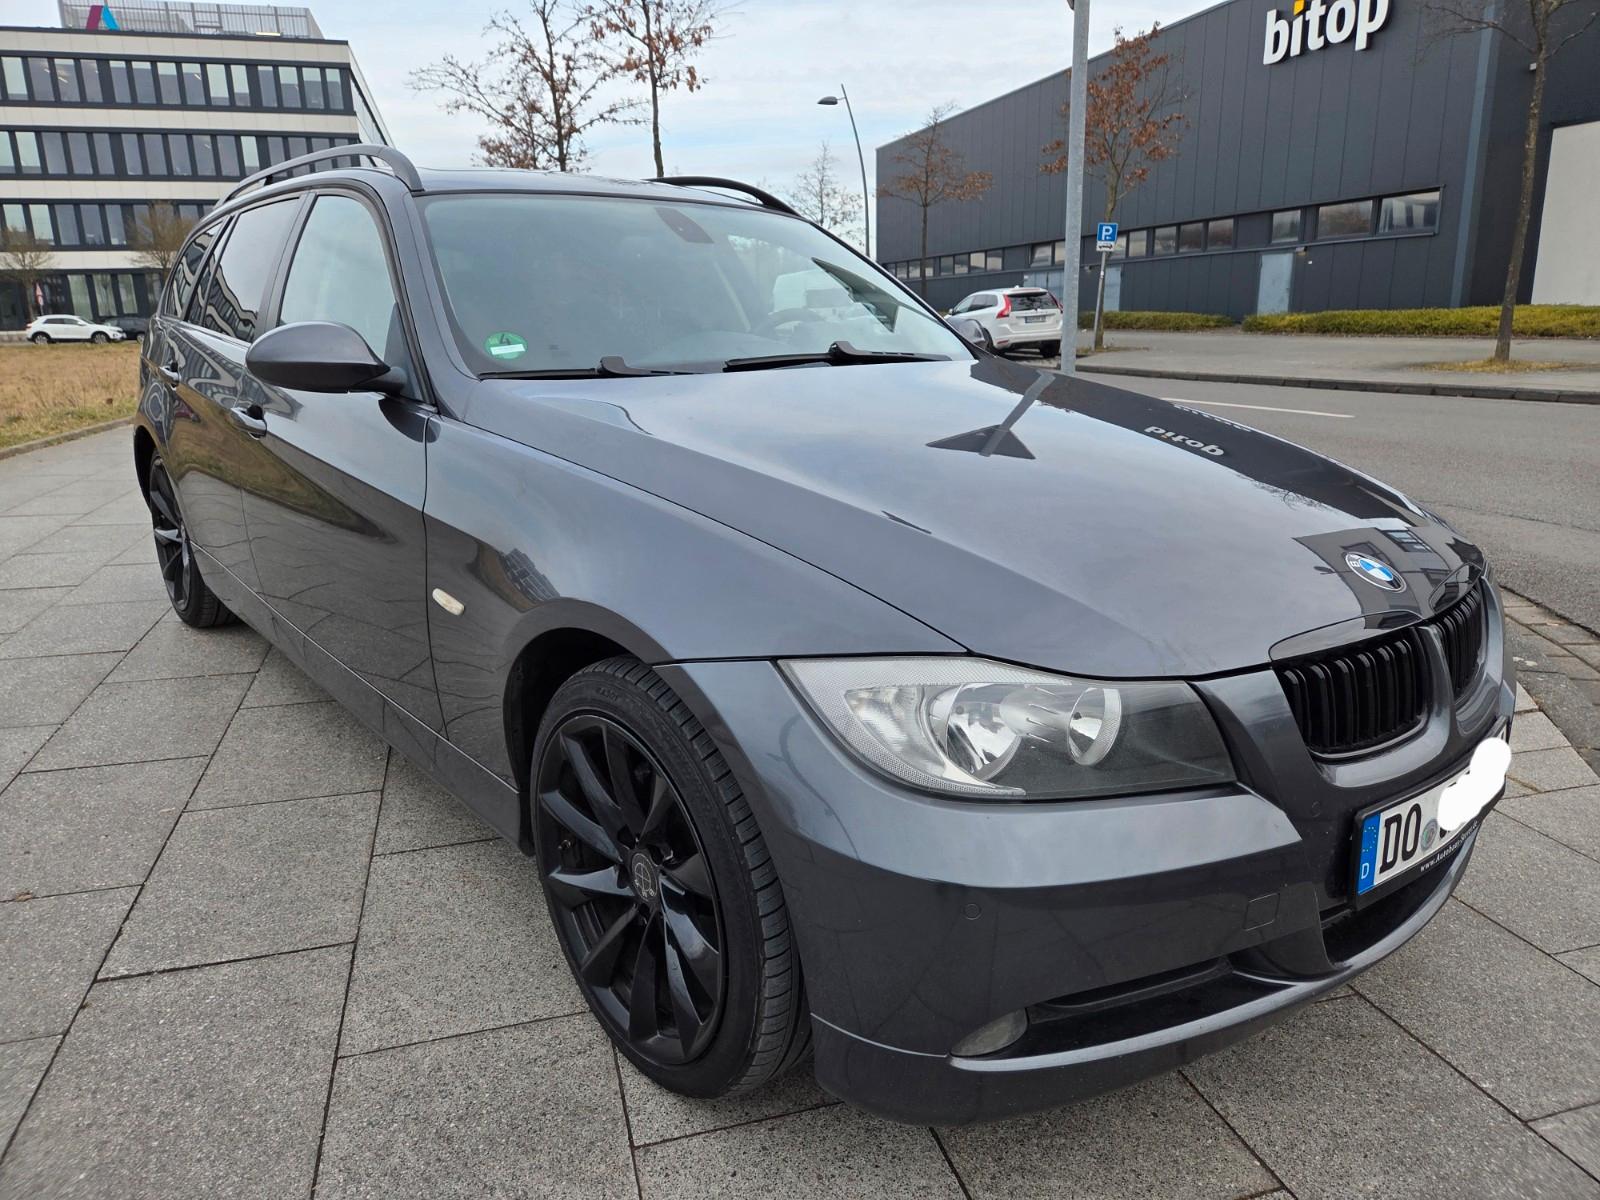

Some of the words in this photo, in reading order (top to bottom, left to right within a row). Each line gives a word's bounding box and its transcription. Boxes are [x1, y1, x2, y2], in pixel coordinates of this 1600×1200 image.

[1263, 0, 1389, 65] bitop
[1102, 225, 1113, 240] P
[1379, 803, 1422, 874] DO
[1360, 862, 1370, 880] D
